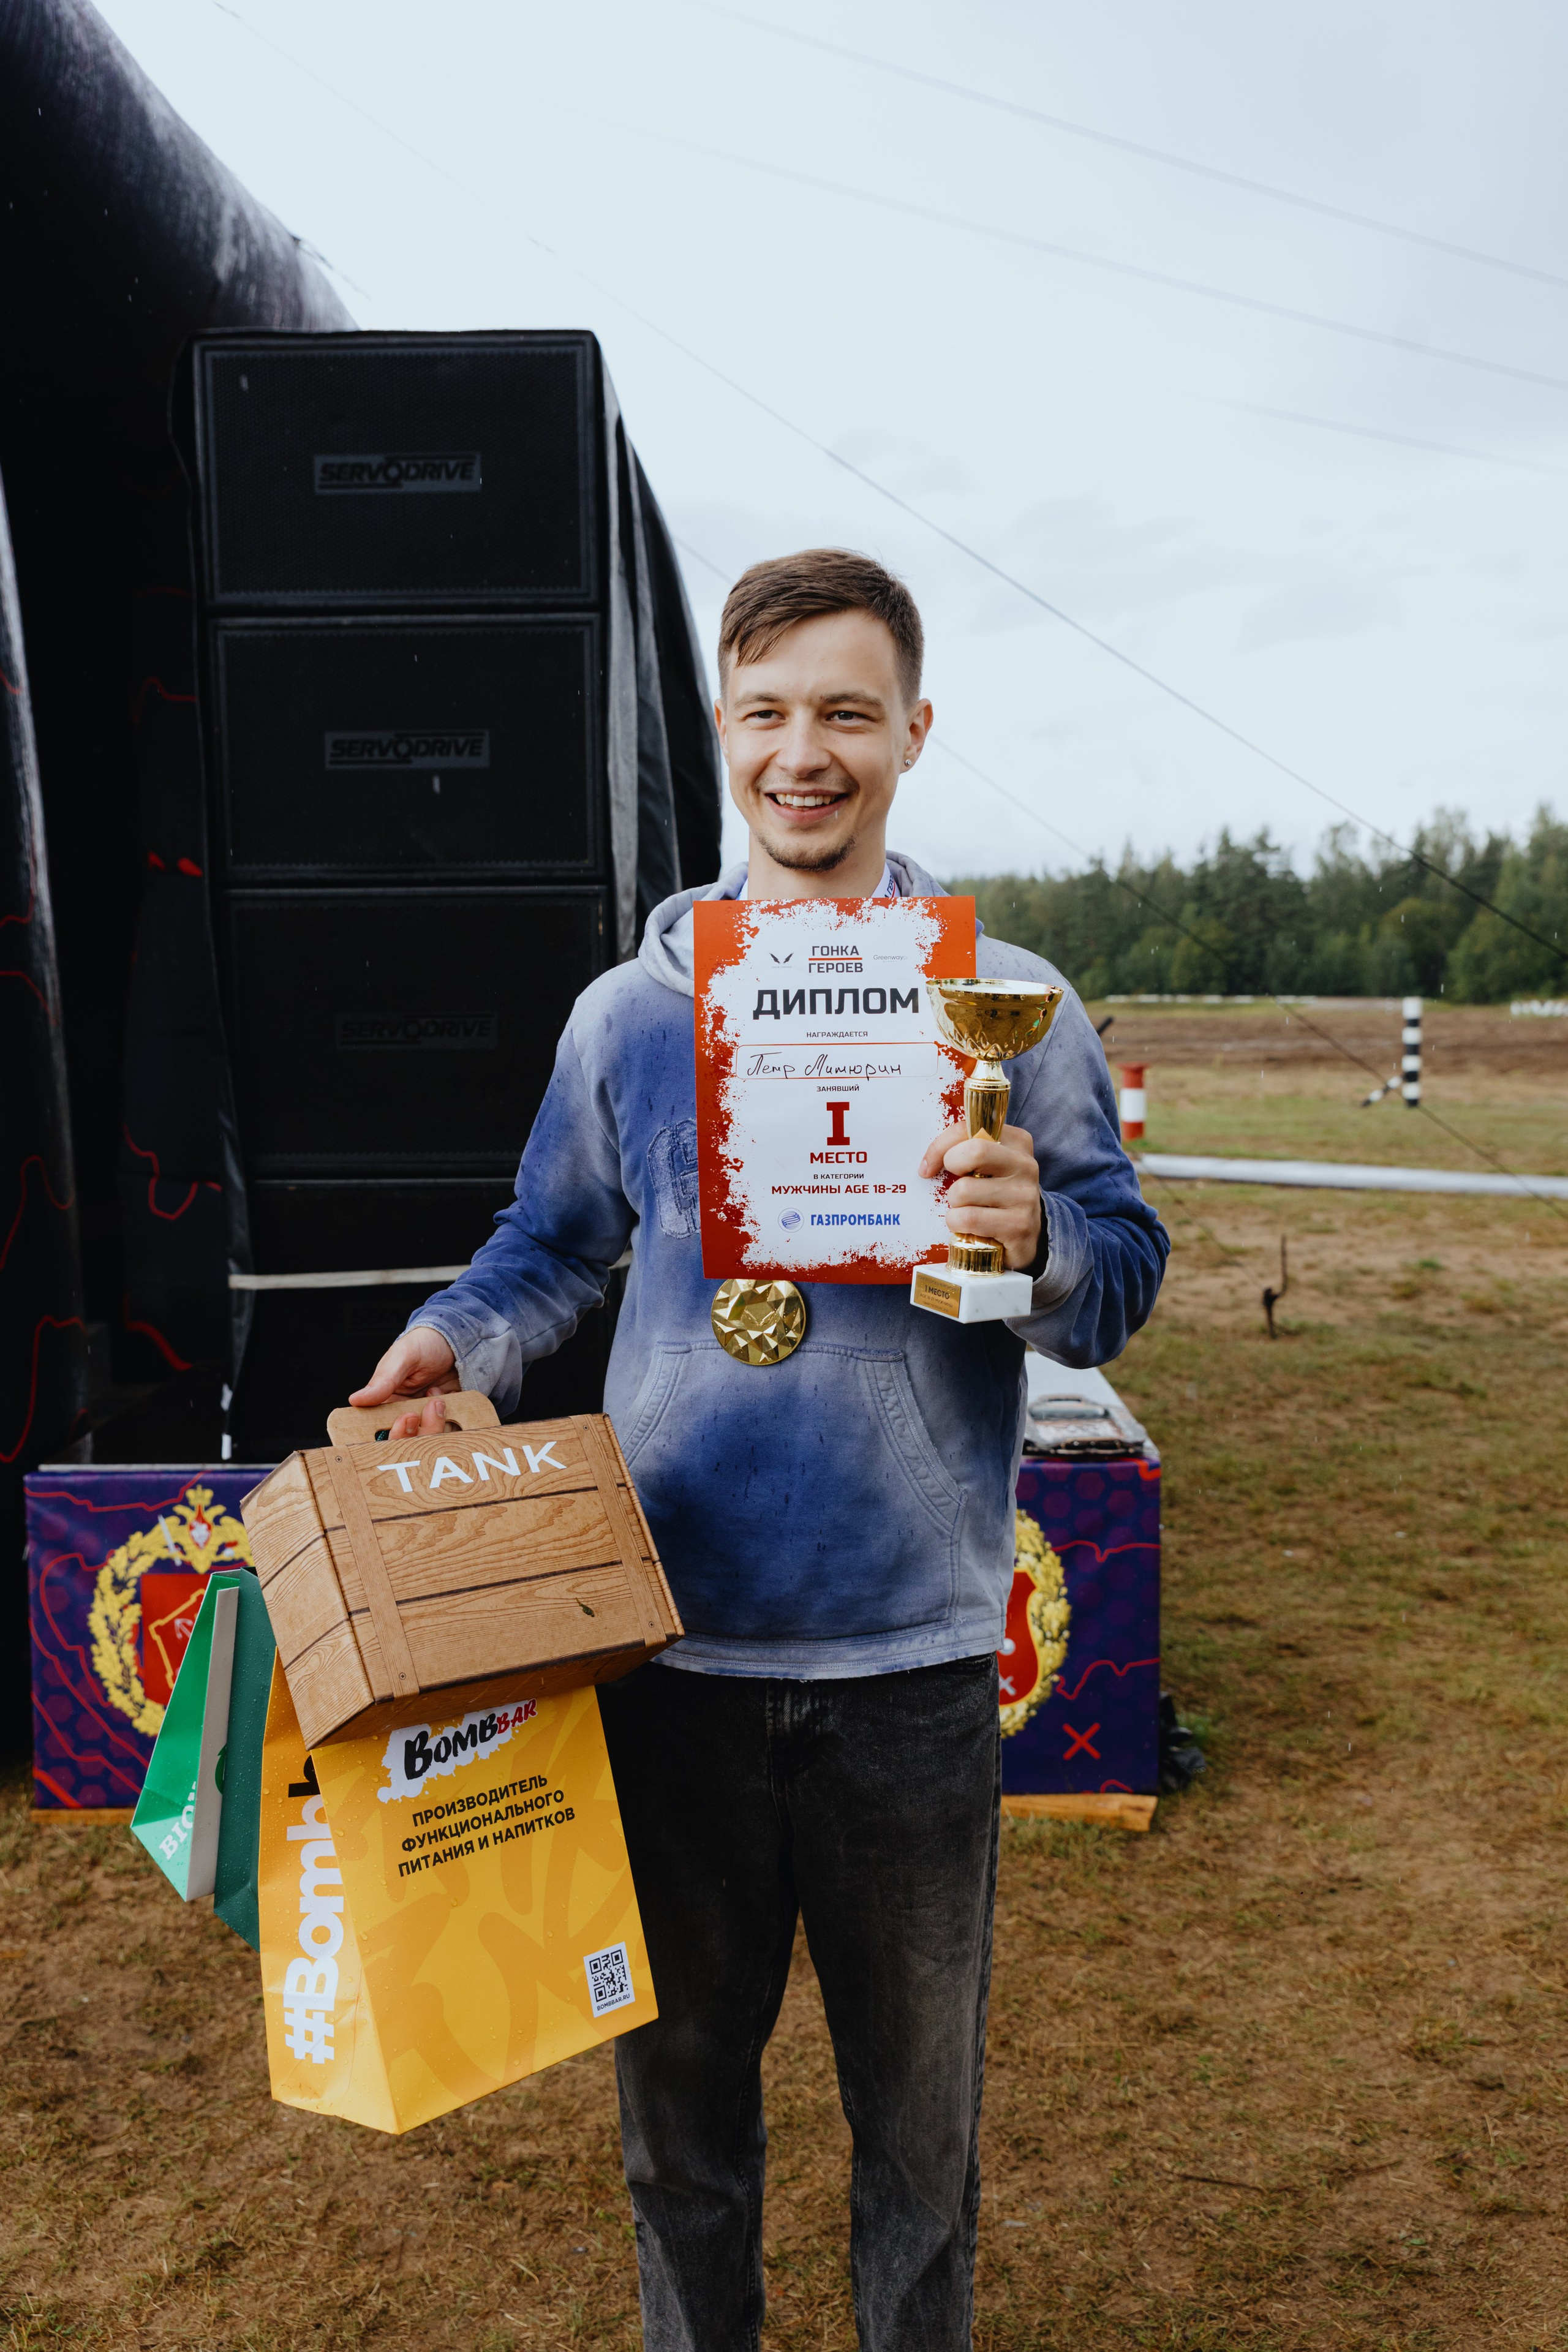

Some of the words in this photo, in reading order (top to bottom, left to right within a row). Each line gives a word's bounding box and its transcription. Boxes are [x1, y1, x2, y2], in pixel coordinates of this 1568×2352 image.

[320, 461, 476, 483] SERVODRIVE
[330, 737, 484, 759] SERVODRIVE
[812, 945, 859, 956] ГОНКА
[809, 962, 864, 973] ГЕРОЕВ
[753, 987, 919, 1020] ДИПЛОМ
[747, 1051, 796, 1079] Петр
[826, 1101, 850, 1146] I
[810, 1151, 868, 1164] МЕСТО
[771, 1185, 841, 1194] МУЖЧИНЫ
[844, 1185, 870, 1194] AGE
[873, 1184, 907, 1194] 18-29
[810, 1213, 901, 1226] ГАЗПРОМБАНК
[928, 1286, 950, 1300] МЕСТО
[376, 1441, 568, 1493] TANK
[412, 1774, 548, 1827] ПРОИЗВОДИТЕЛЬ
[402, 1790, 564, 1852] ФУНКЦИОНАЛЬНОГО
[398, 1840, 475, 1877] ПИТАНИЯ
[479, 1835, 489, 1850] И
[492, 1807, 575, 1846] НАПИТКОВ
[597, 1993, 630, 2011] BOMBBAR.RU
